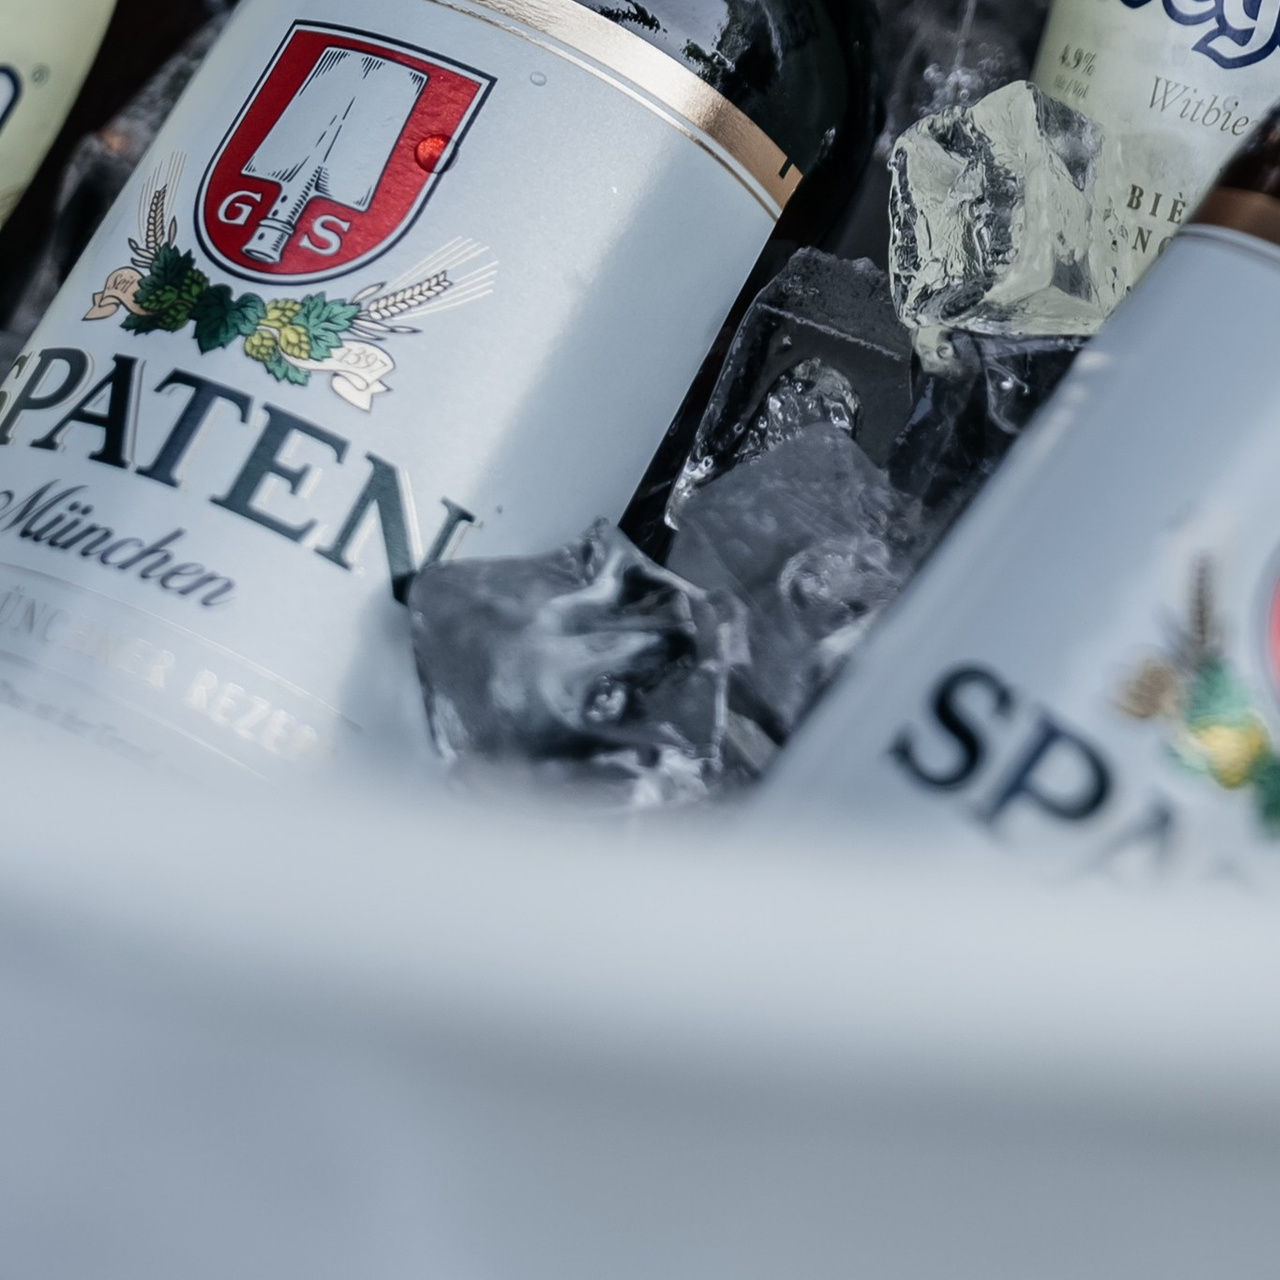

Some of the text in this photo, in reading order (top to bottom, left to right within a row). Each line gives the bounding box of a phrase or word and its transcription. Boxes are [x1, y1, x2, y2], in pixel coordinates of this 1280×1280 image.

[1149, 75, 1260, 137] Witbie
[217, 190, 351, 257] G S
[336, 346, 390, 375] 1397
[0, 478, 238, 608] München
